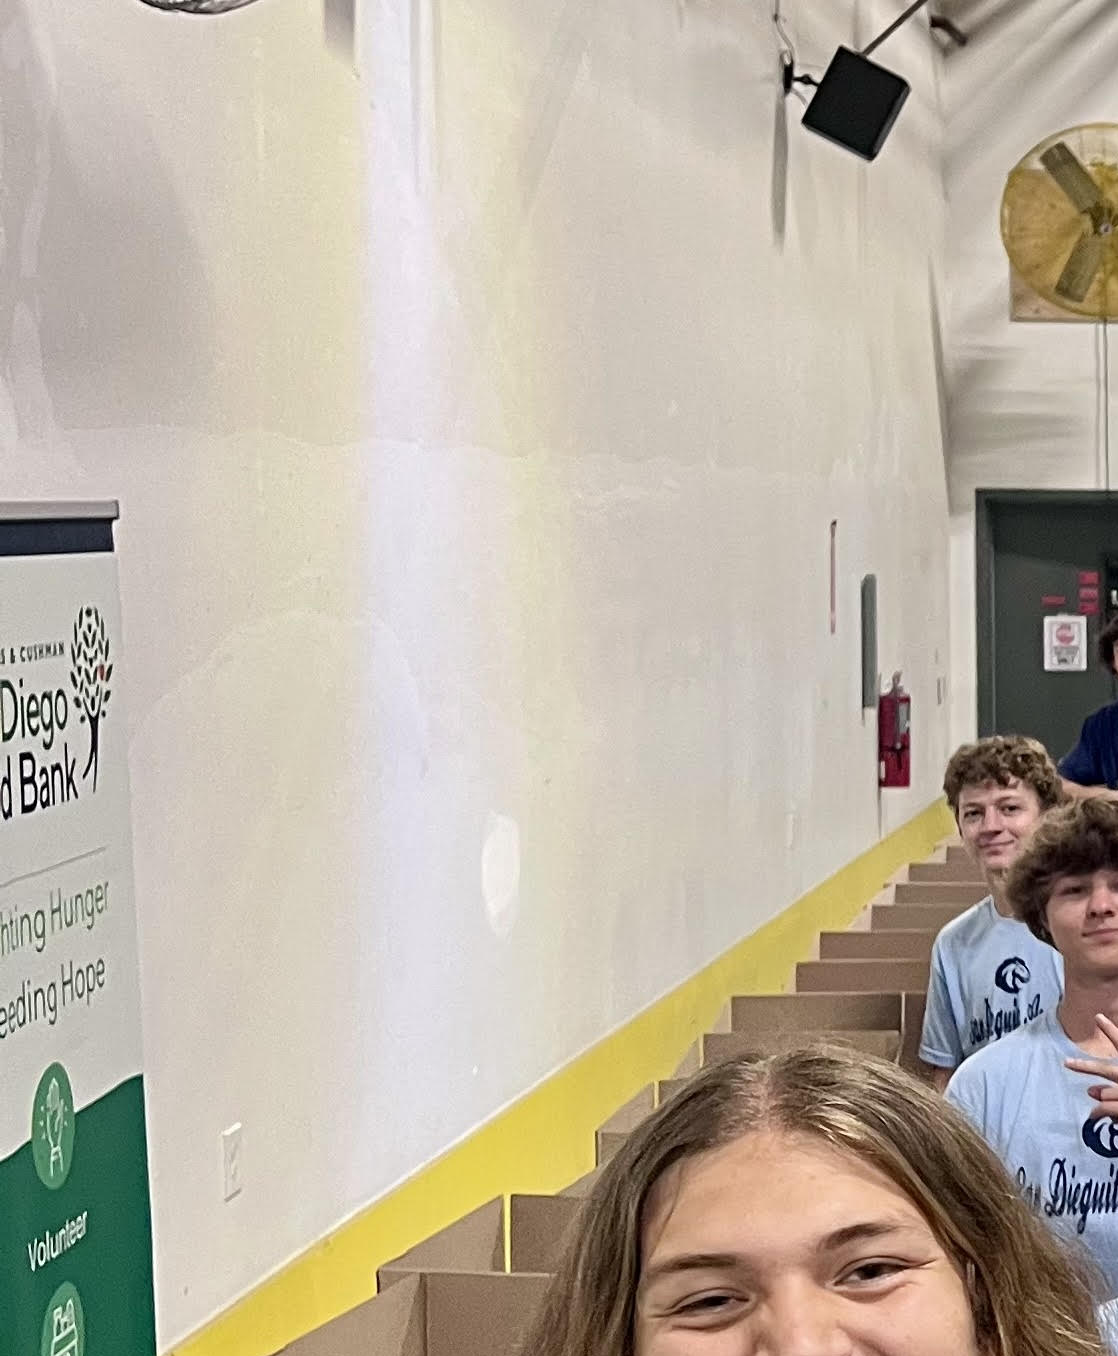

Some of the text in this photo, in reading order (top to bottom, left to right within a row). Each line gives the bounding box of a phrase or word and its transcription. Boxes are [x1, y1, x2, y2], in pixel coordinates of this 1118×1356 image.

[19, 640, 65, 663] CUSHMAN
[0, 678, 68, 750] Diego
[19, 742, 79, 815] Bank
[0, 881, 109, 956] hting Hunger
[0, 958, 105, 1039] eeding Hope
[28, 1210, 88, 1272] Volunteer
